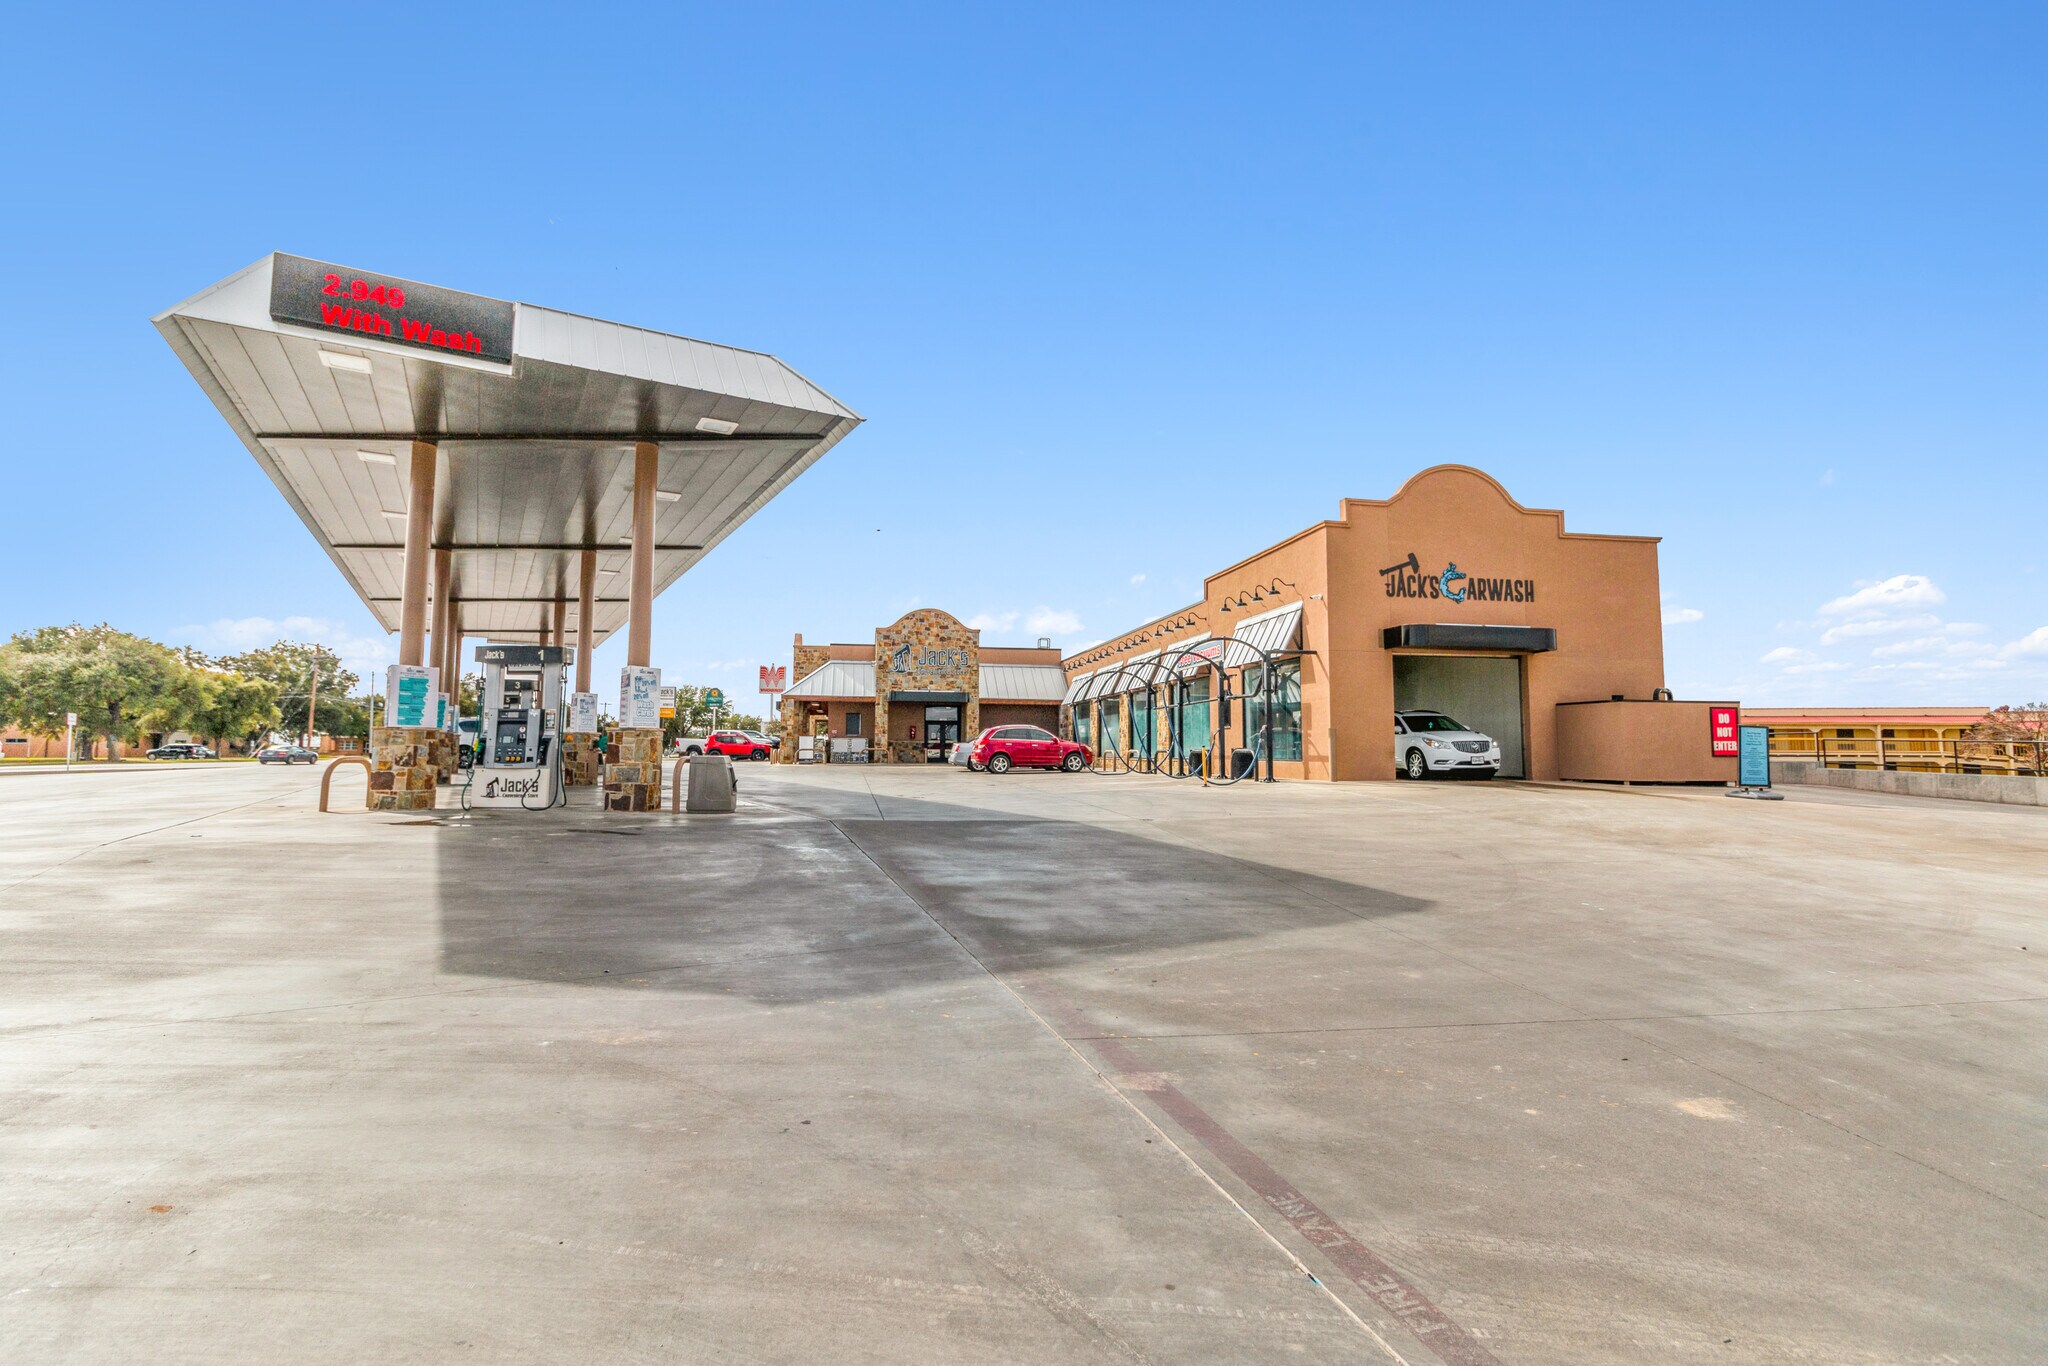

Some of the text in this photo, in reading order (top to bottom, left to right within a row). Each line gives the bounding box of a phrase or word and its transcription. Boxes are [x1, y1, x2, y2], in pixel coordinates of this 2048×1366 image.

[322, 273, 405, 308] 2.949
[320, 303, 482, 353] With Wash
[485, 650, 544, 660] Jack's 1
[917, 645, 969, 667] Jack's
[515, 681, 521, 689] 3
[1718, 713, 1730, 723] DO
[1717, 727, 1733, 737] NOT
[1713, 741, 1737, 751] ENTER
[501, 778, 539, 793] Jack's
